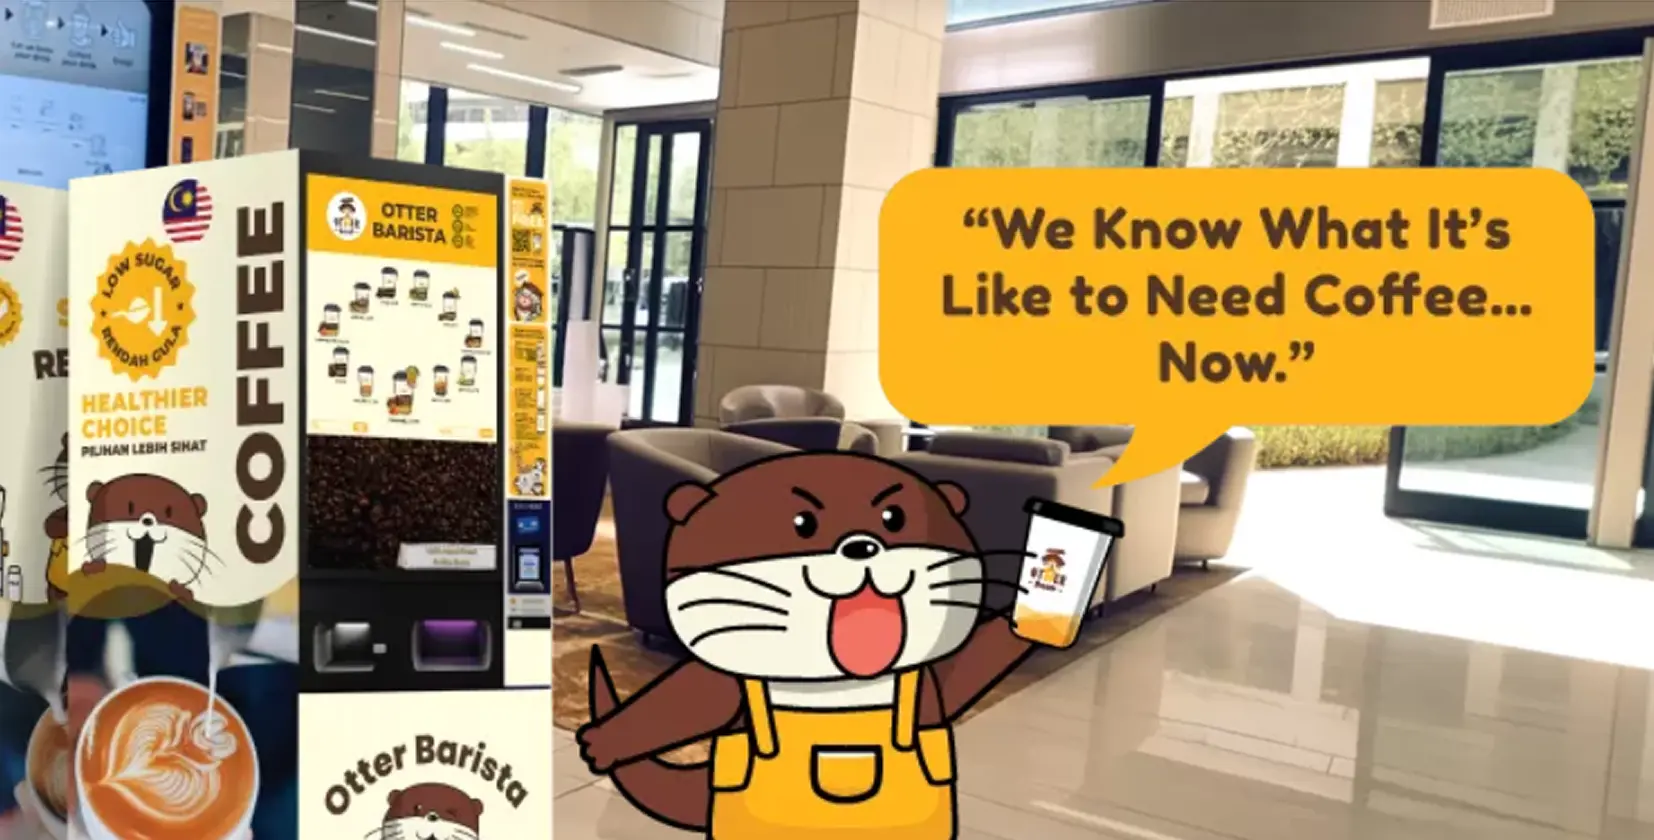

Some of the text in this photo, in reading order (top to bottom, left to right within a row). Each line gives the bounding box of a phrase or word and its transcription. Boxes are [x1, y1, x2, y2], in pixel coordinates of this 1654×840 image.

[381, 202, 438, 223] OTTER
[372, 222, 447, 245] BARISTA
[102, 252, 181, 299] LOW SUGAR
[101, 325, 182, 367] RENDAH GULA
[235, 201, 286, 564] COFFEE
[81, 386, 208, 413] HEALTHIER
[81, 415, 167, 438] CHOICE
[132, 442, 167, 454] LEBIH
[171, 439, 207, 453] SIHAT
[324, 734, 529, 816] Otter Barista
